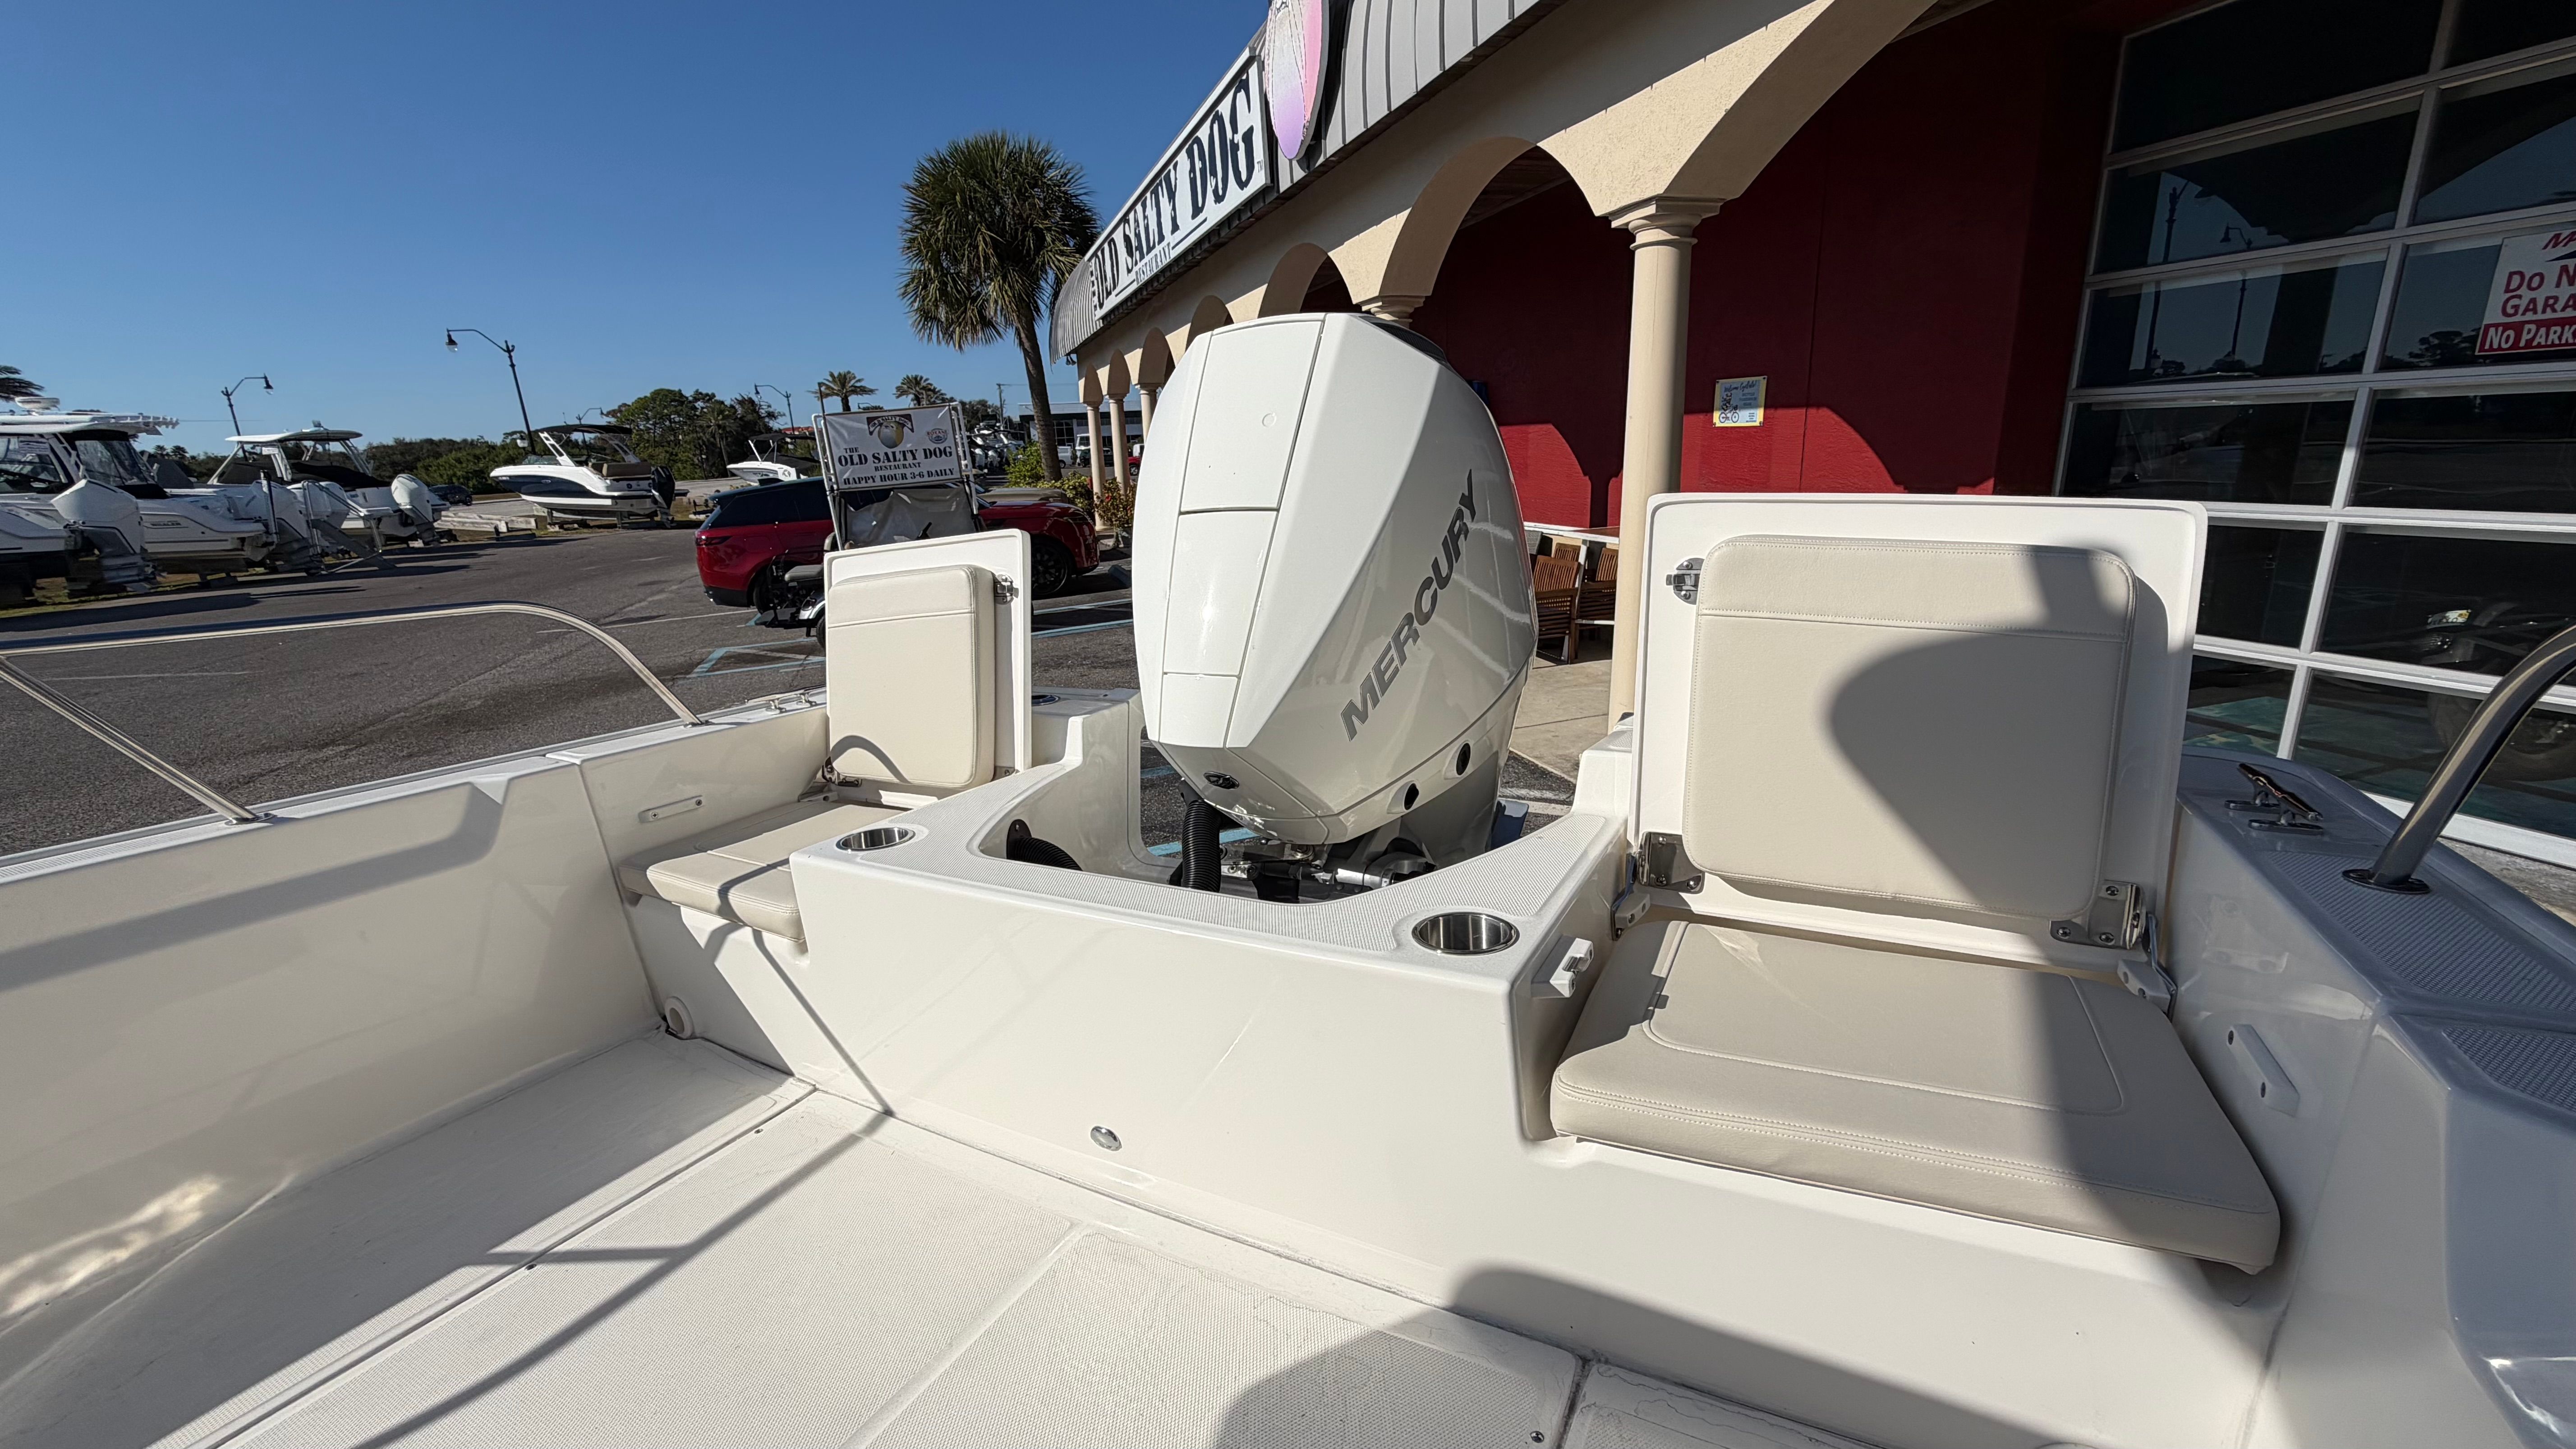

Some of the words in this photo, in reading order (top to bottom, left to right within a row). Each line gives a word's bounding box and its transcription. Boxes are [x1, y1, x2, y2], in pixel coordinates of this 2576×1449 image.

[1094, 237, 1119, 310] OLD
[1123, 160, 1181, 276] SALTY
[1186, 70, 1255, 220] DOG
[1135, 241, 1172, 285] RESTAURANT
[2519, 324, 2576, 347] PARK
[838, 453, 868, 467] OLD
[872, 449, 918, 464] SALTY
[922, 446, 952, 460] DOG
[874, 462, 921, 472] RESTAURANT
[843, 475, 877, 485] HAPPY
[880, 473, 908, 482] HOUR
[910, 471, 925, 479] 3-6
[927, 468, 955, 478] DAILY
[1340, 469, 1477, 742] MERCURY
